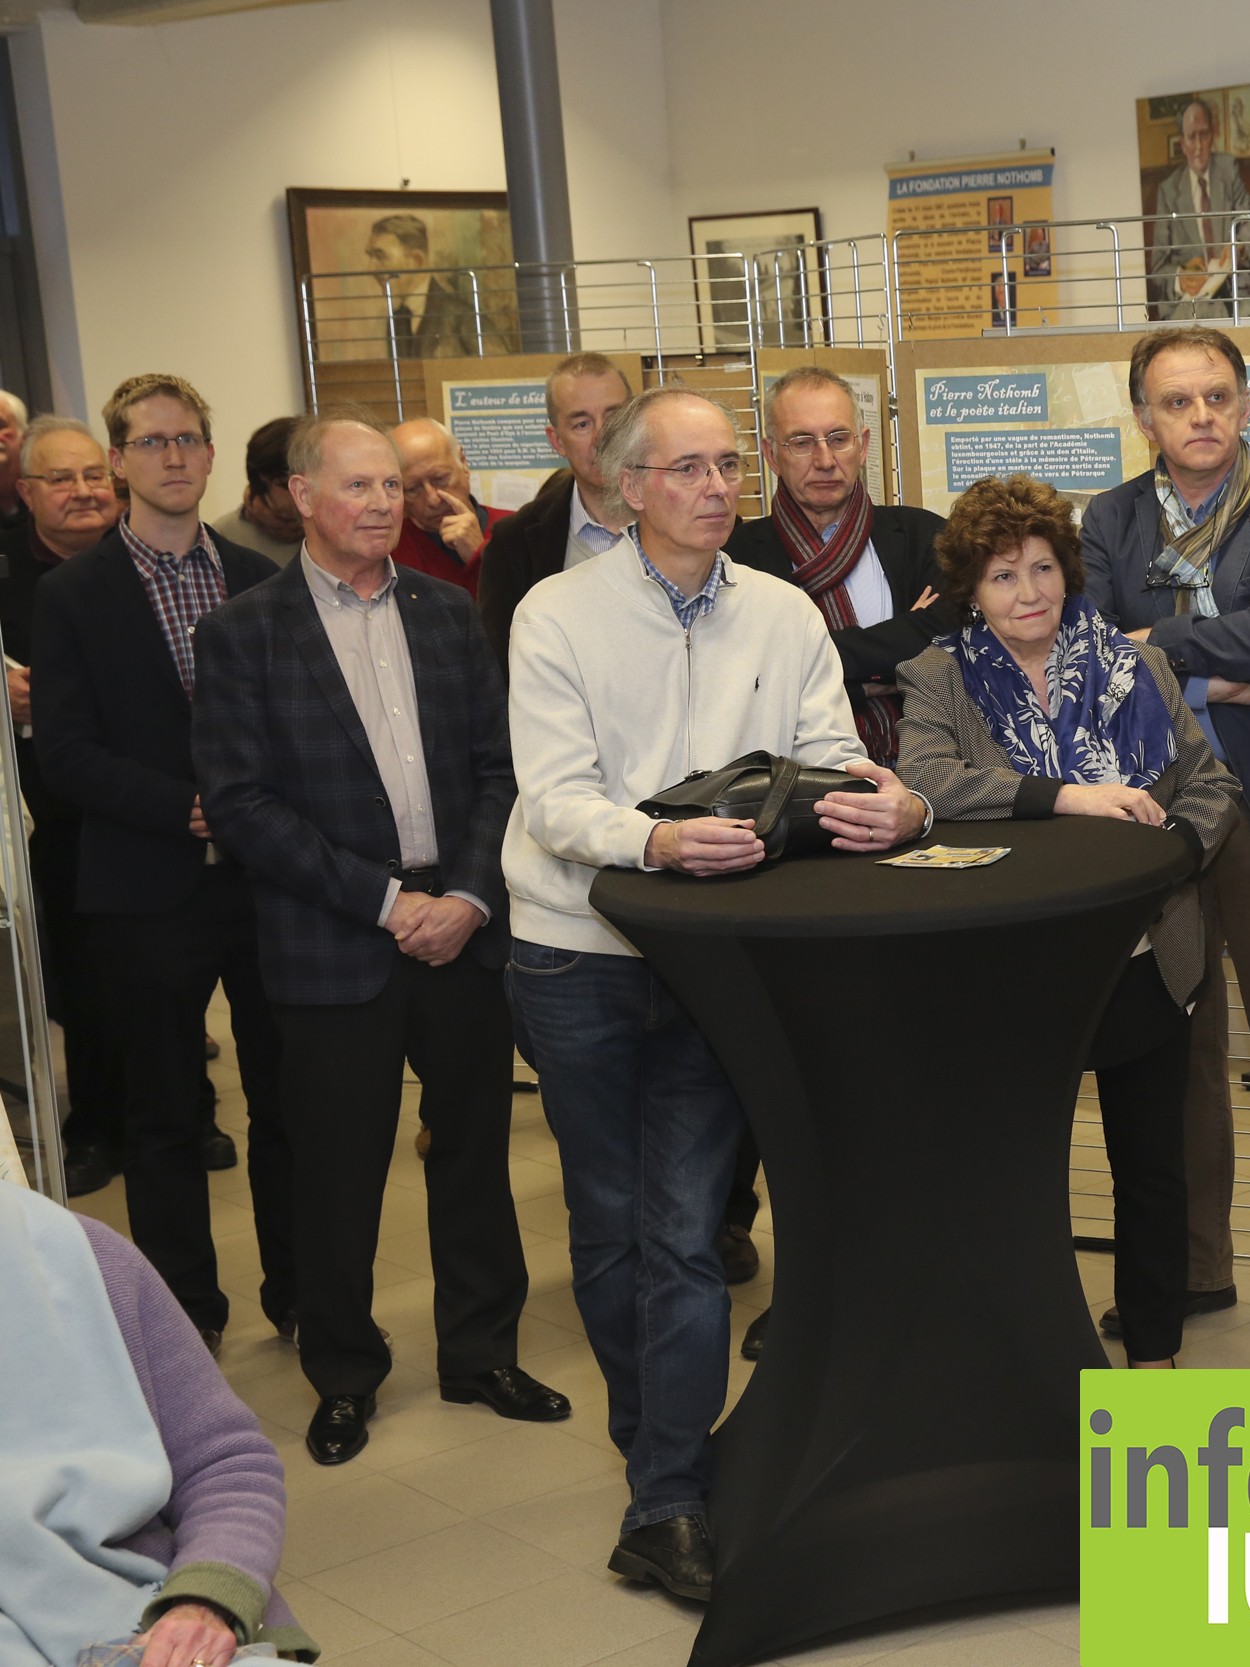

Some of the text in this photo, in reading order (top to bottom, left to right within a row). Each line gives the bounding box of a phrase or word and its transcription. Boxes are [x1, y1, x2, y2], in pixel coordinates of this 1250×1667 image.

[897, 170, 1043, 194] LA FONDATION PIERRE NOTHOMB
[930, 379, 1040, 400] Pierre Nothomb
[508, 393, 520, 405] de
[523, 392, 546, 405] théâ
[930, 400, 1042, 422] et le poète italien
[1019, 449, 1038, 457] grâce
[1080, 454, 1117, 462] Pétrarque.
[973, 465, 996, 473] plaque
